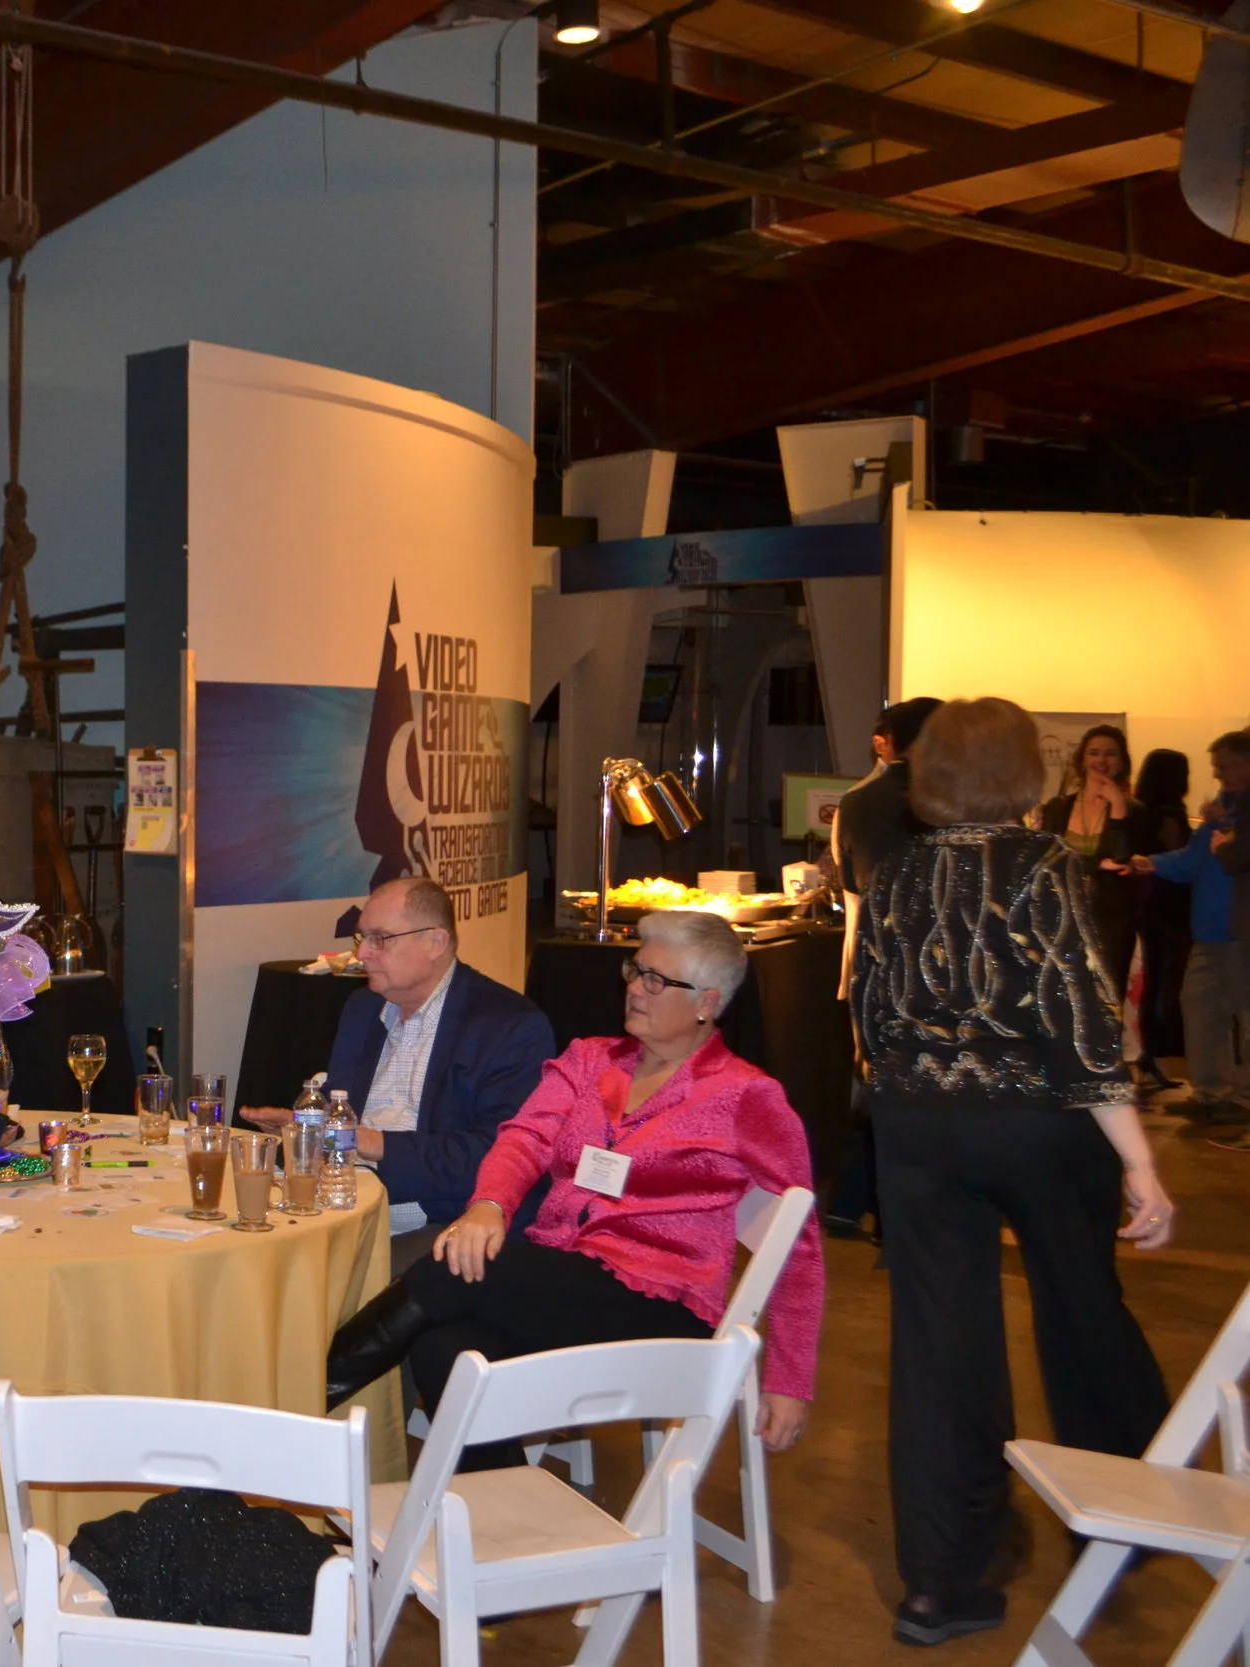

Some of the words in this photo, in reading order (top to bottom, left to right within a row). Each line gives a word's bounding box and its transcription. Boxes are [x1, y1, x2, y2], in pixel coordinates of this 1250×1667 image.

[414, 632, 478, 693] VIDEO
[422, 692, 492, 753] GAME
[428, 754, 510, 815] WIZARDS
[439, 858, 477, 887] SCIENCE
[448, 888, 470, 922] TO
[478, 881, 508, 917] GAMES
